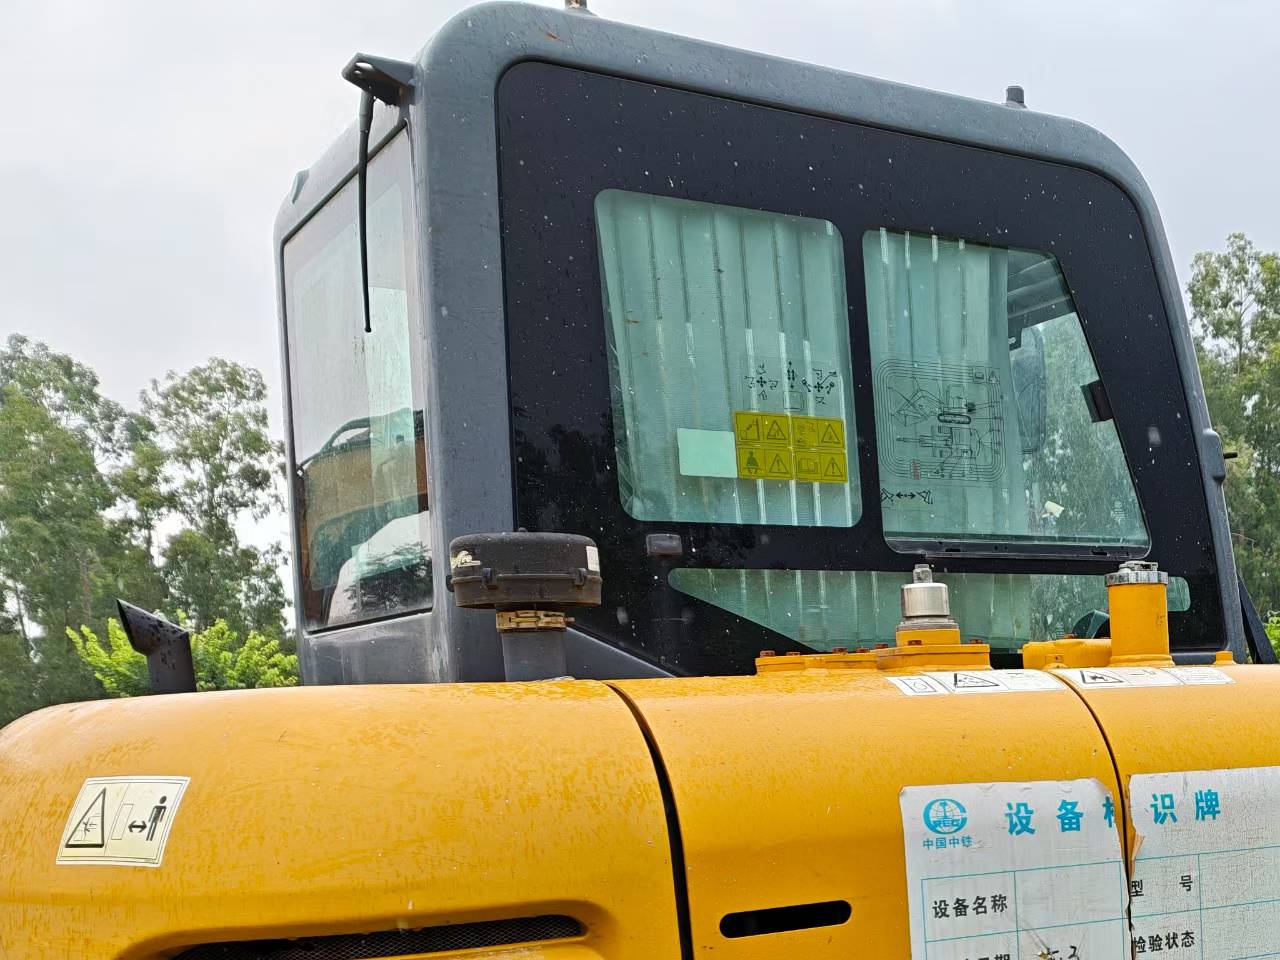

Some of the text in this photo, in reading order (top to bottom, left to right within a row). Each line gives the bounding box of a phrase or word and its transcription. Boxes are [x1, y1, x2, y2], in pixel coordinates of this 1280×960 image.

[922, 834, 973, 851] 中国中铁
[932, 893, 1008, 919] 设备名称
[1133, 930, 1195, 954] 检验状态
